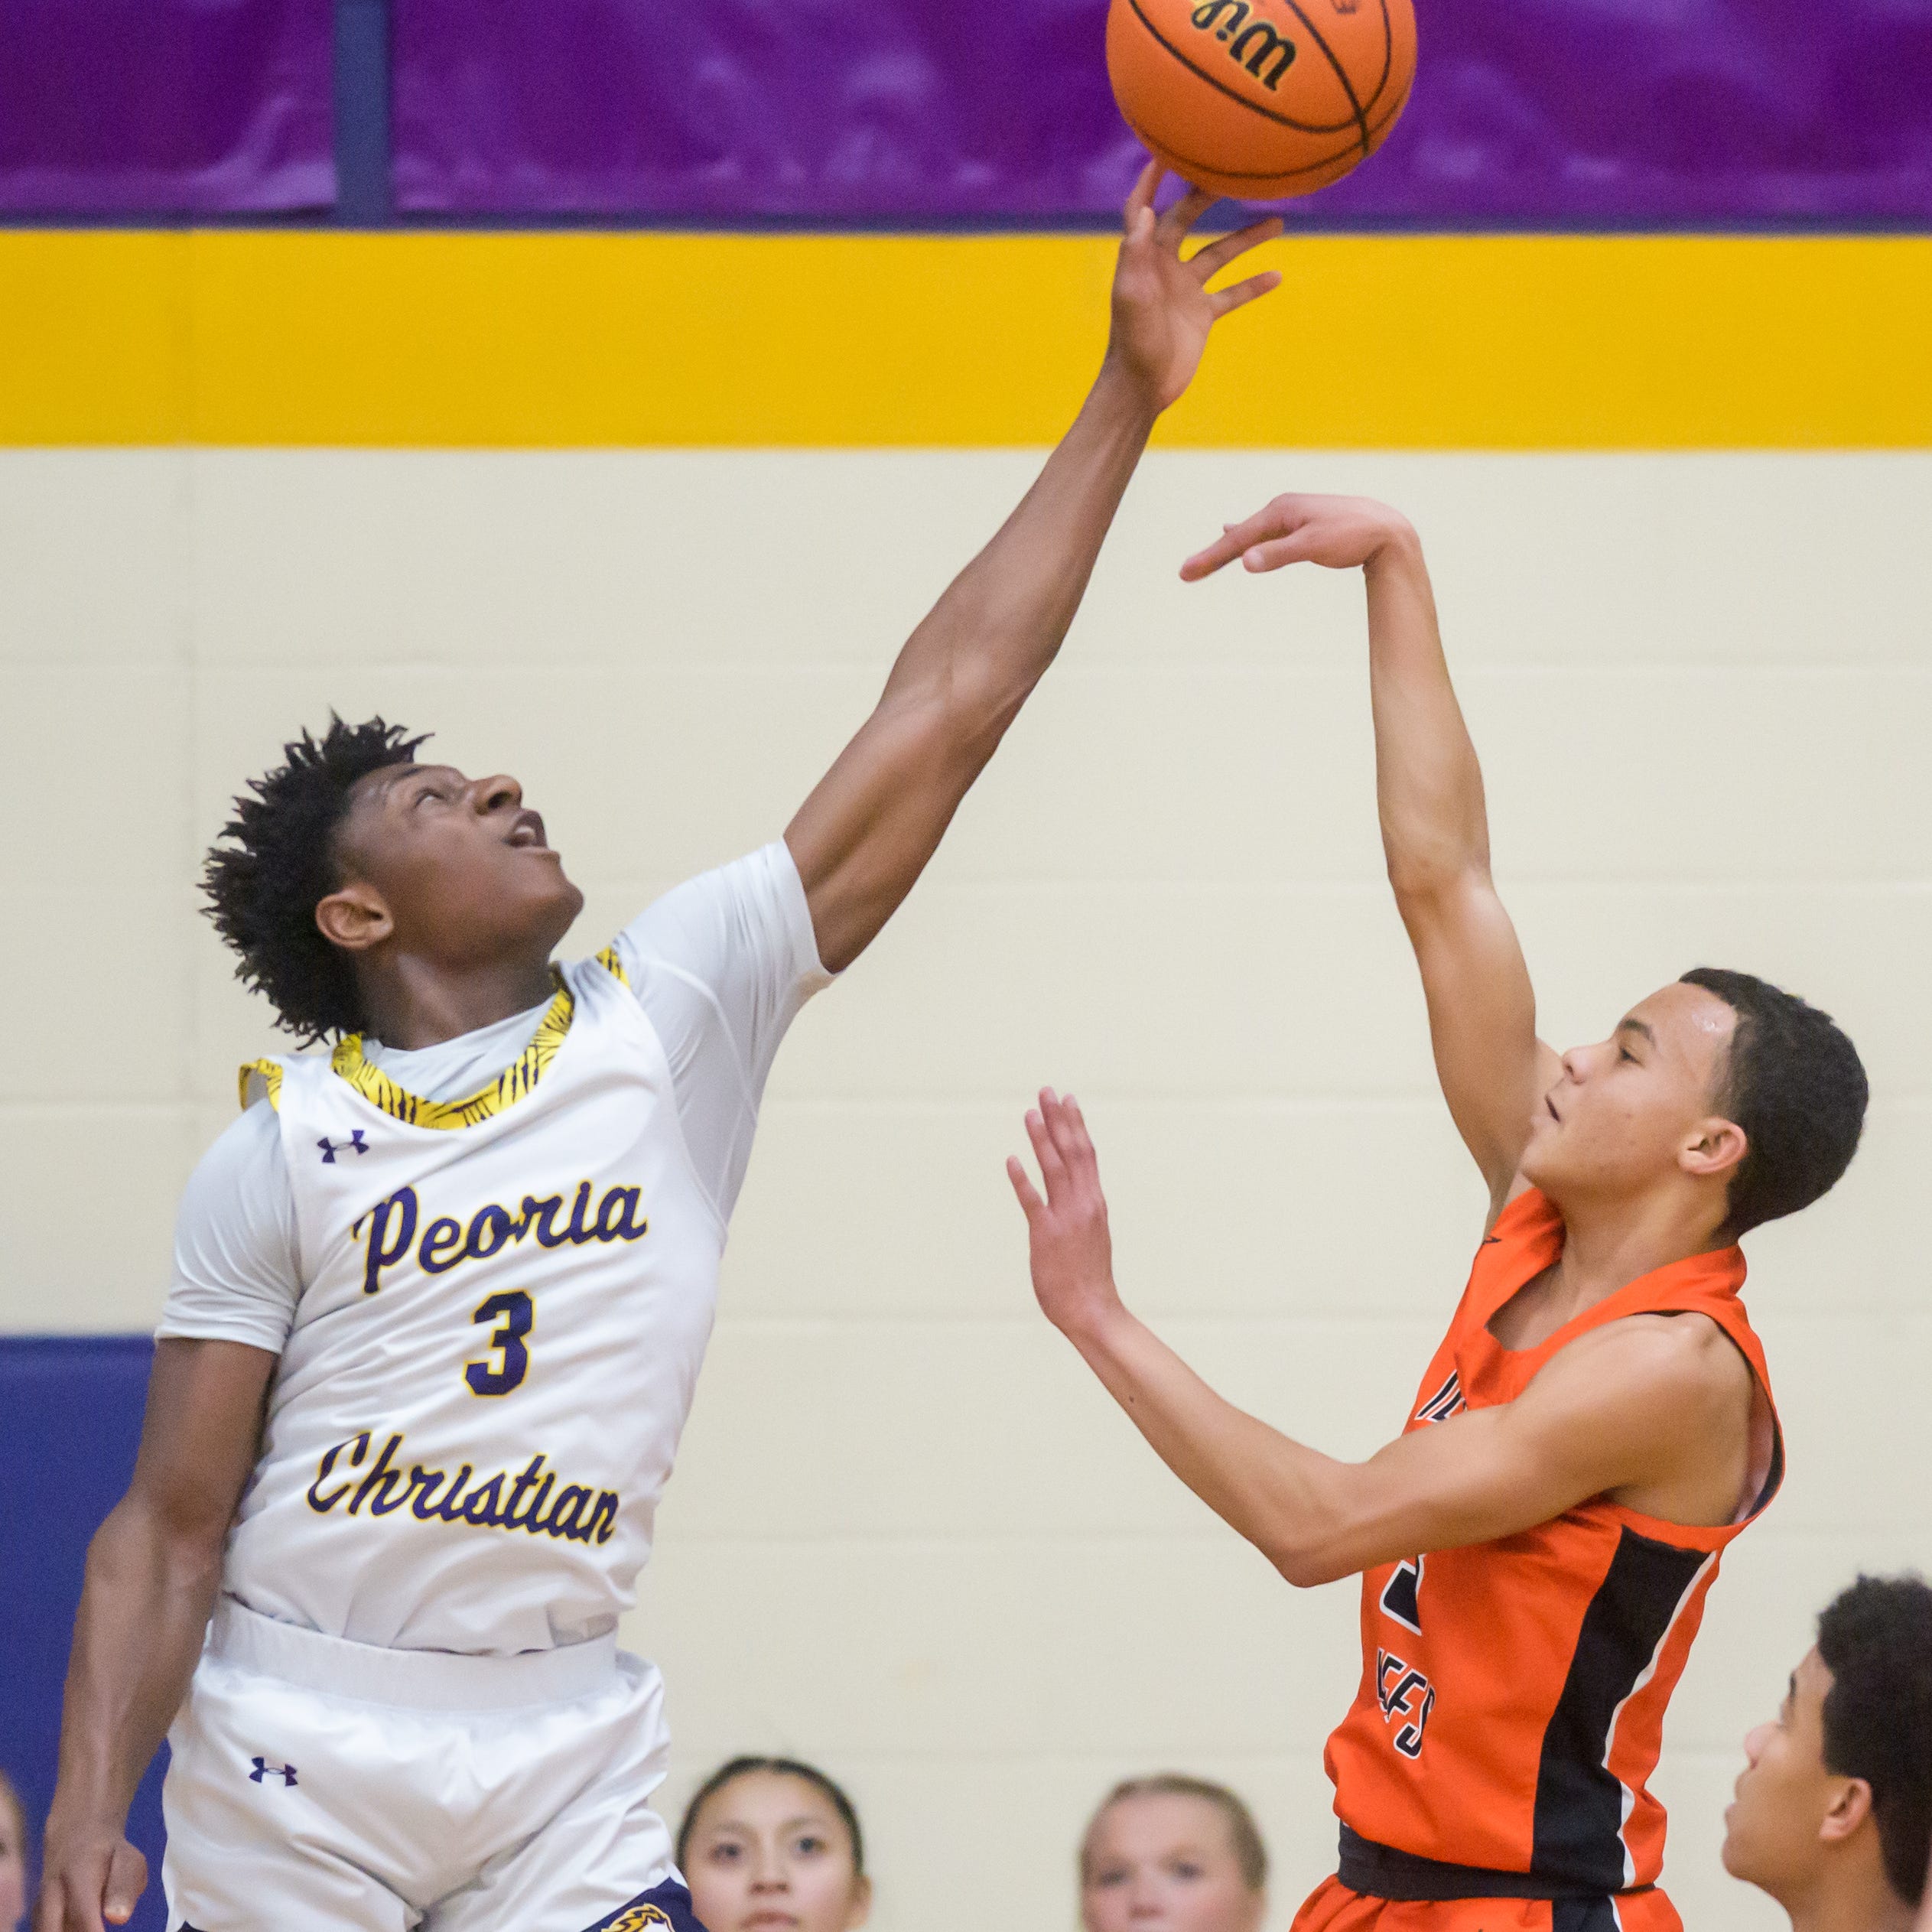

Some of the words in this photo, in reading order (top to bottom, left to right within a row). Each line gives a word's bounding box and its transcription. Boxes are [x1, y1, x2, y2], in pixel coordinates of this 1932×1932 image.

[351, 1181, 648, 1293] Peoria
[463, 1289, 535, 1397] 3
[306, 1431, 620, 1546] Christian
